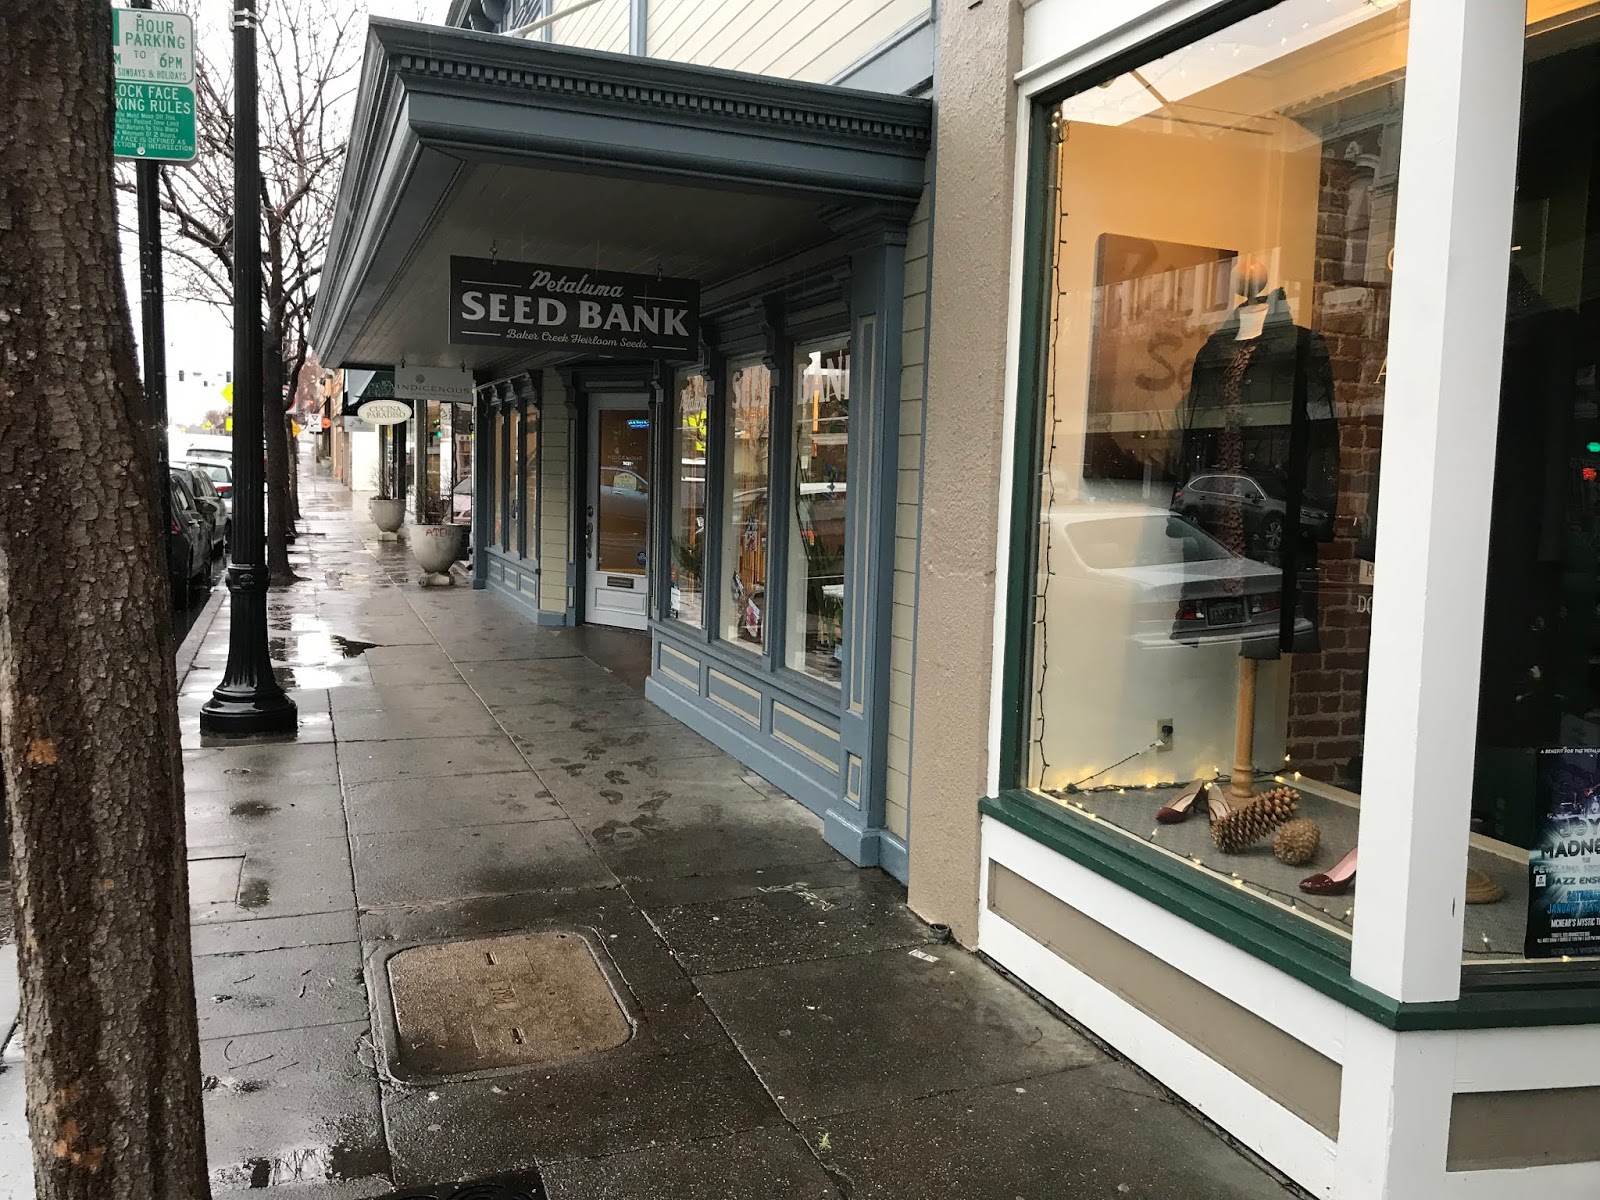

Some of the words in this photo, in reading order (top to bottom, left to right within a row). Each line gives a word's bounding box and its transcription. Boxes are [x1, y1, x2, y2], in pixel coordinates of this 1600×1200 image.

[136, 19, 174, 34] HOUR
[126, 32, 185, 49] PARKING
[134, 50, 146, 59] TO
[159, 53, 183, 69] 6PM
[118, 68, 146, 78] SUNDAYS
[157, 71, 187, 81] HOLIDAYS
[115, 84, 143, 98] OCK
[148, 86, 179, 100] FACE
[116, 98, 145, 112] KING
[150, 100, 191, 114] RULES
[528, 269, 625, 298] Petaluma
[461, 291, 567, 326] SEED
[578, 300, 689, 337] BANK
[506, 329, 539, 341] Baker
[541, 332, 569, 343] Creek
[570, 333, 617, 347] Heirloom
[619, 338, 649, 349] Seeds
[397, 384, 470, 394] INDIGENOUS
[366, 411, 406, 419] PARADISO
[1541, 838, 1600, 860] MADNE
[1551, 876, 1576, 885] JAZZ
[1577, 917, 1595, 926] MYSTIC
